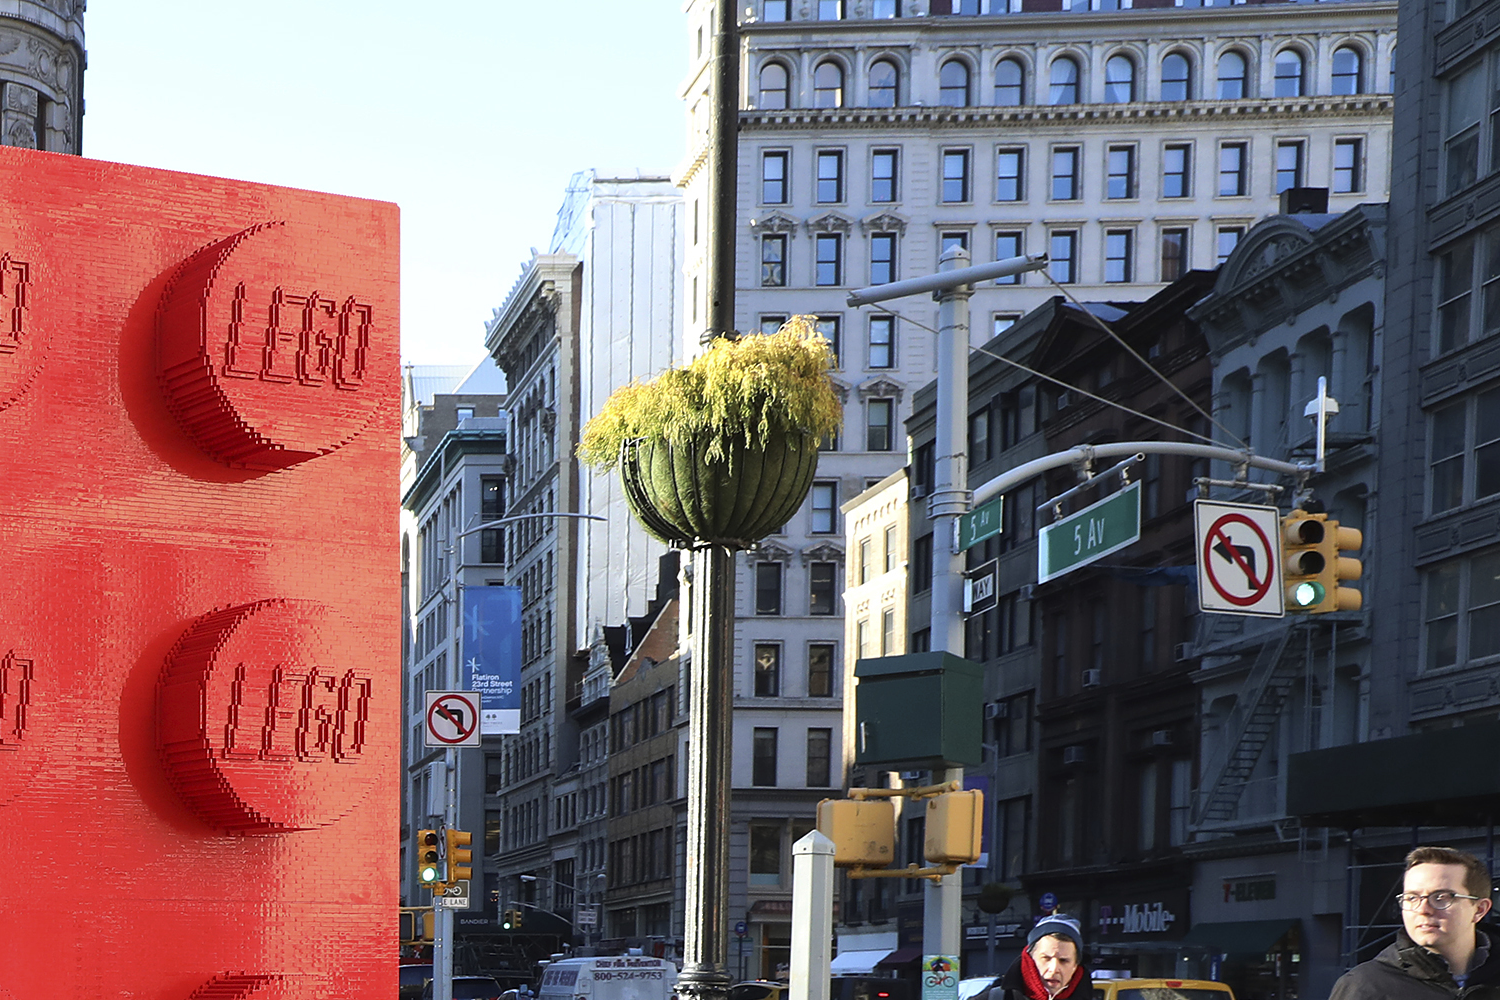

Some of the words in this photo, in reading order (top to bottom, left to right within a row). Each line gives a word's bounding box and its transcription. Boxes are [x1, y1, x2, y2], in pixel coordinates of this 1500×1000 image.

[221, 281, 374, 391] LEGO
[970, 514, 977, 541] 5
[1074, 524, 1081, 556] 5
[471, 673, 500, 681] Flatiron
[490, 680, 513, 688] Street
[221, 662, 374, 765] LEGO
[450, 898, 467, 906] LANE
[594, 971, 663, 981] 800-524-9753
